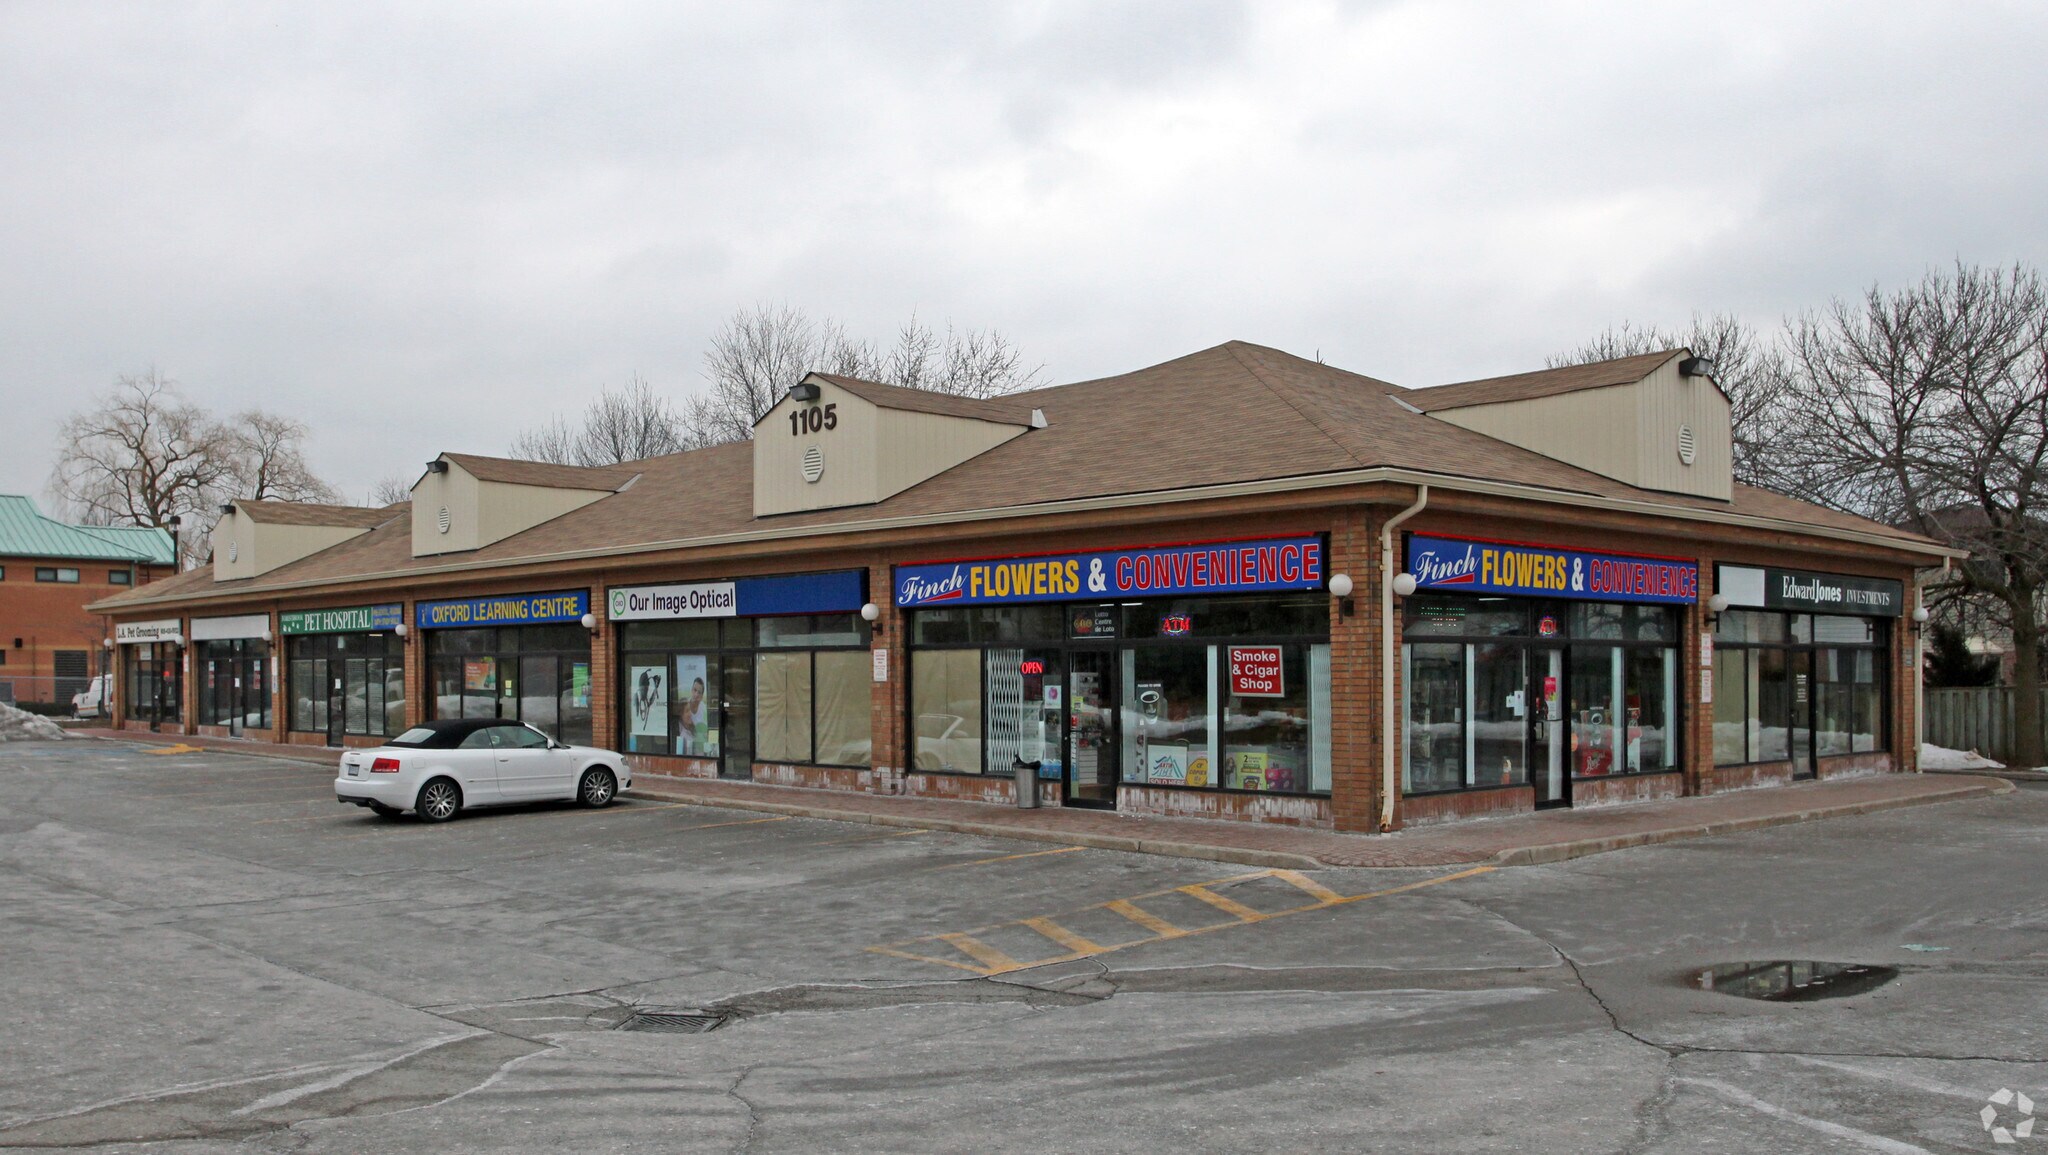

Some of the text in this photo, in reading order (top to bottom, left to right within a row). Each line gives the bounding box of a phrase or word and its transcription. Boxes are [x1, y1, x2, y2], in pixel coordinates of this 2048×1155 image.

[789, 403, 837, 436] 1105
[898, 543, 1320, 604] Finch FLOWERS & CONVENIENCE
[1413, 545, 1697, 598] Finch FLOWERS & CONVENIENCE
[629, 588, 734, 614] Our Image Optical
[1846, 589, 1890, 606] INVESTMENTS
[432, 596, 578, 623] OXFORD LEARNING CENTRE
[304, 609, 371, 631] PET HOSPITAL
[1163, 618, 1190, 632] ATM
[127, 627, 136, 638] Pet
[136, 625, 160, 640] Grooming
[1233, 650, 1277, 662] Smoke
[1021, 661, 1043, 674] OPEN
[1232, 664, 1279, 678] & Cigar
[1240, 678, 1273, 692] Shop
